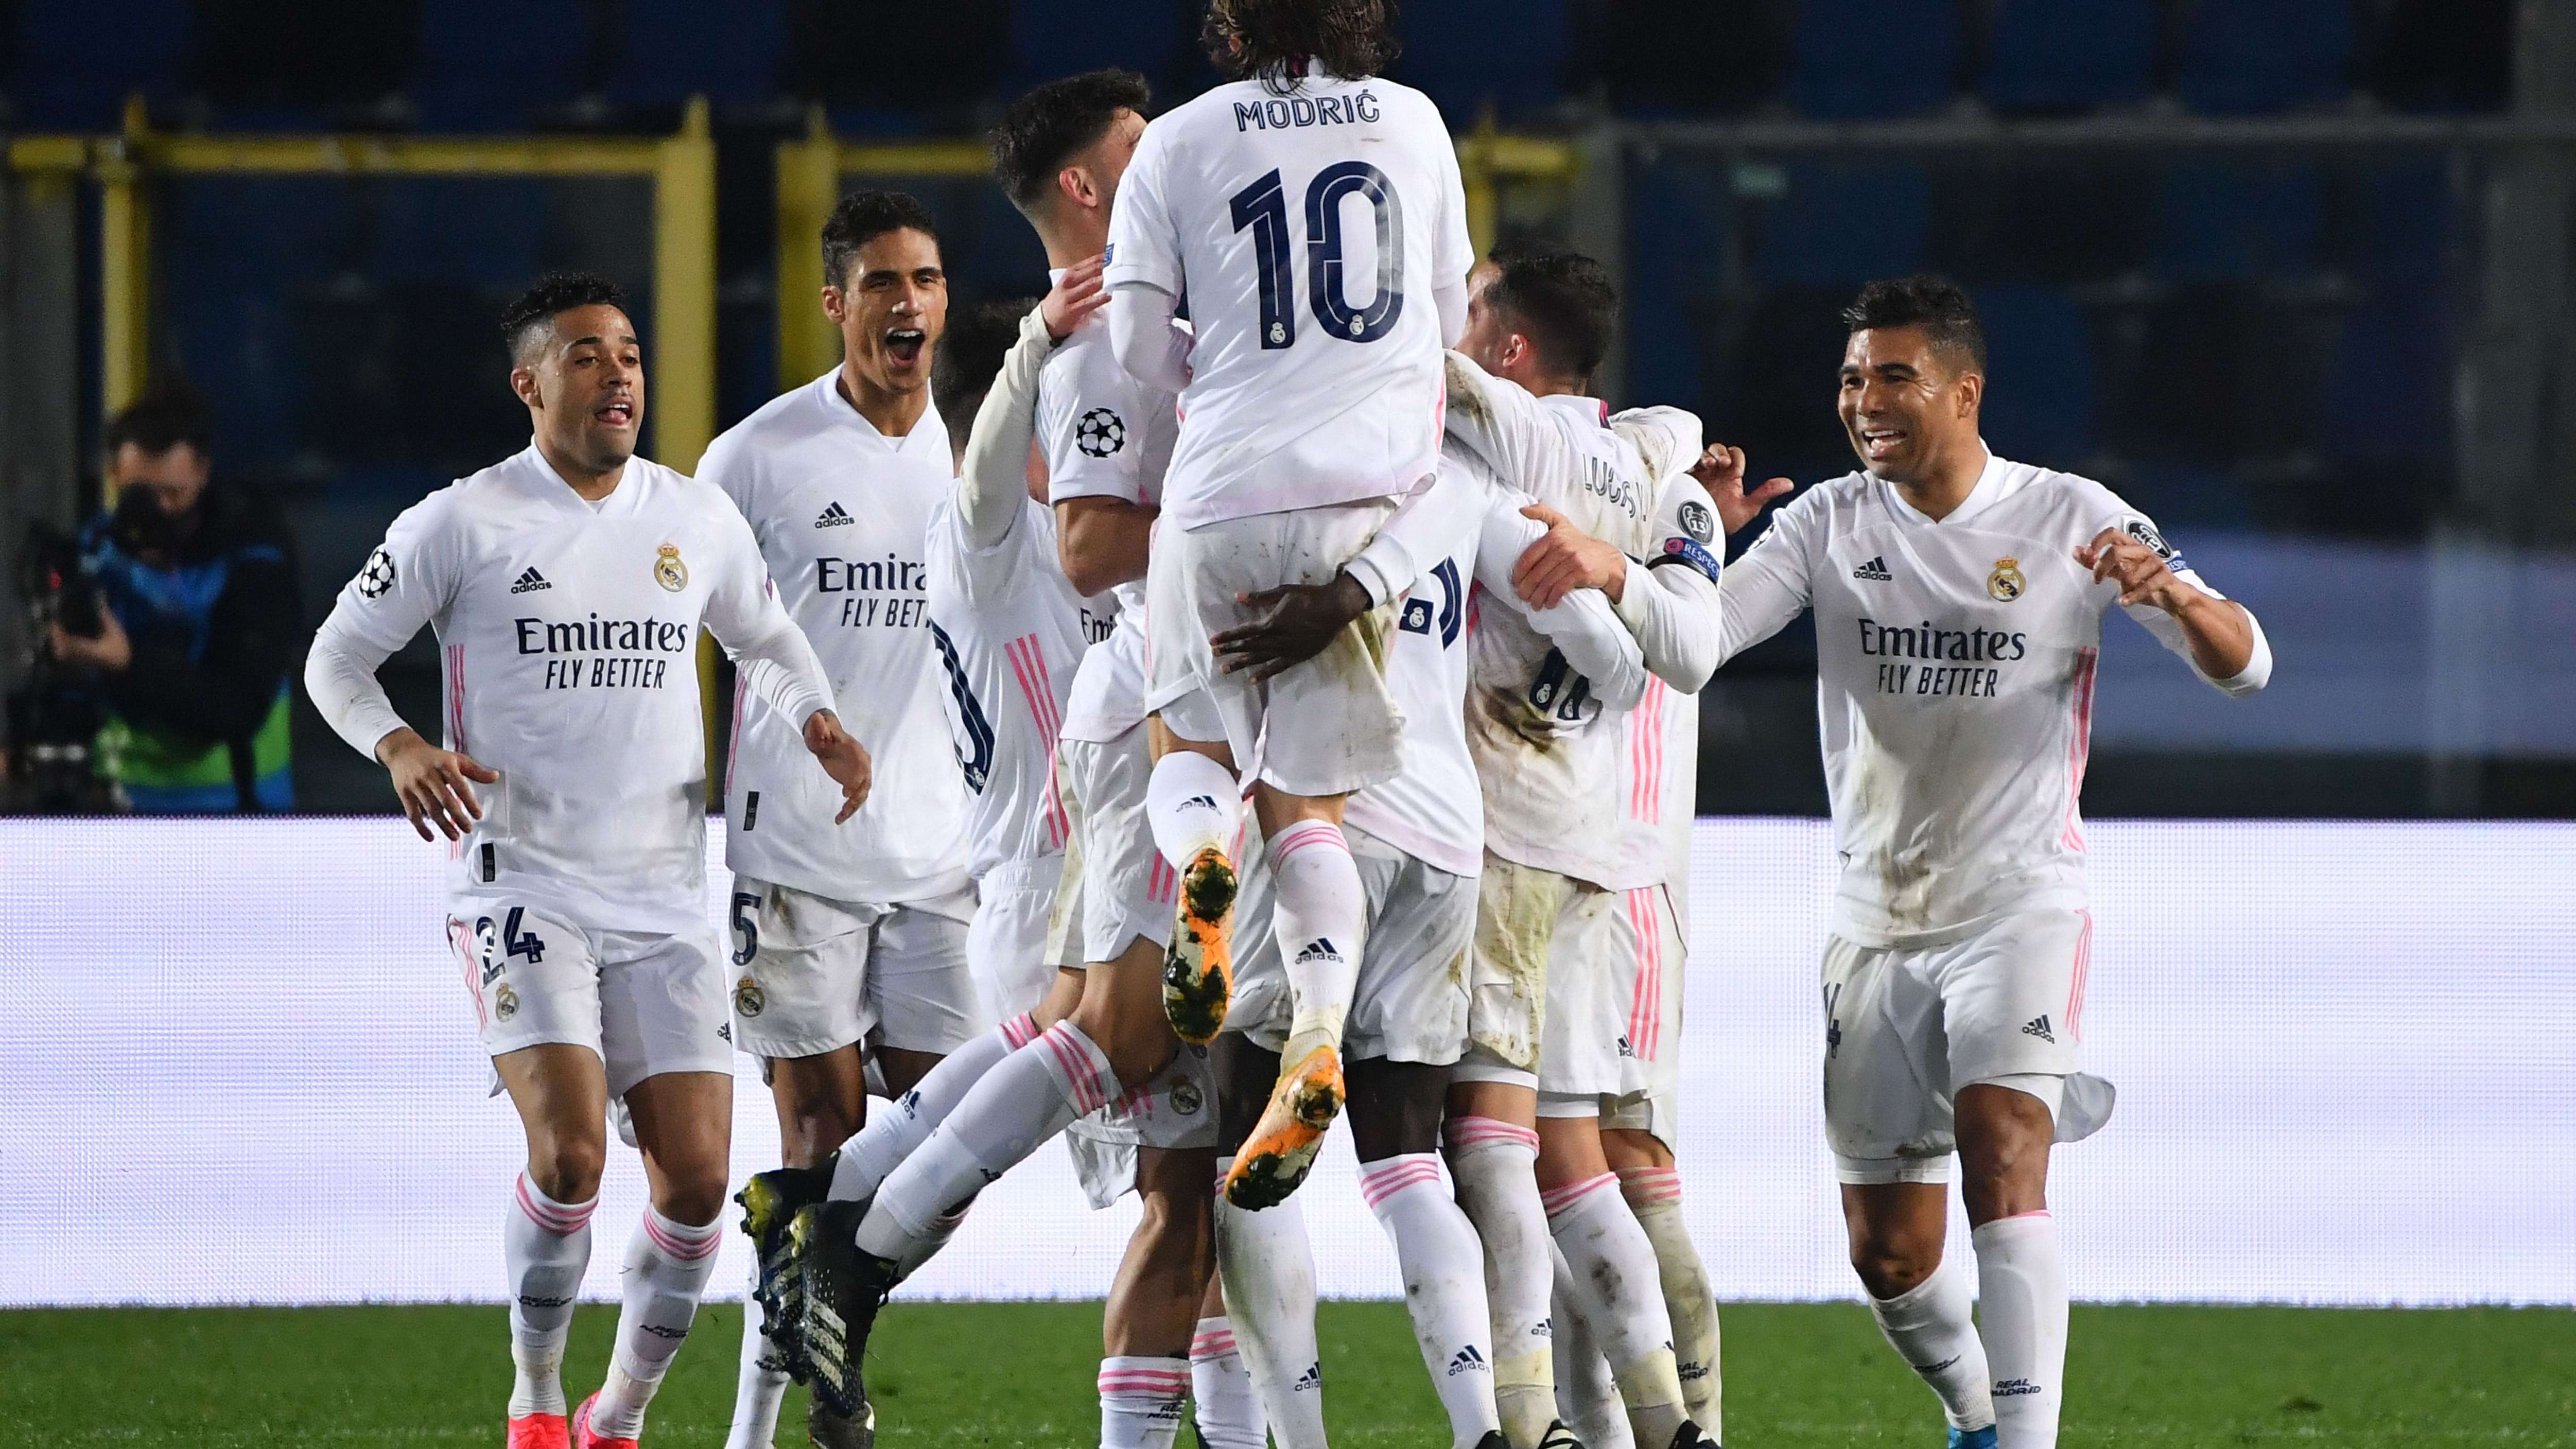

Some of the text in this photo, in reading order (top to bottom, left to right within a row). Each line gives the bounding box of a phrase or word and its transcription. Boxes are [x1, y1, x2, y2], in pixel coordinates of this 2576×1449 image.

[1233, 89, 1380, 132] MODRIĆ
[1229, 160, 1404, 350] 10
[814, 516, 855, 529] adidas
[511, 581, 552, 594] adidas
[1853, 569, 1892, 582] adidas
[841, 598, 879, 627] FLY
[514, 612, 688, 655] Emirates
[1857, 618, 2026, 661] Emirates
[545, 658, 667, 690] FLY BETTER
[1878, 664, 1998, 697] FLY BETTER
[732, 892, 762, 966] 5
[475, 906, 545, 989] 24
[1295, 953, 1345, 964] adidas
[1448, 1360, 1490, 1377] adidas
[1995, 1378, 2031, 1389] REAL
